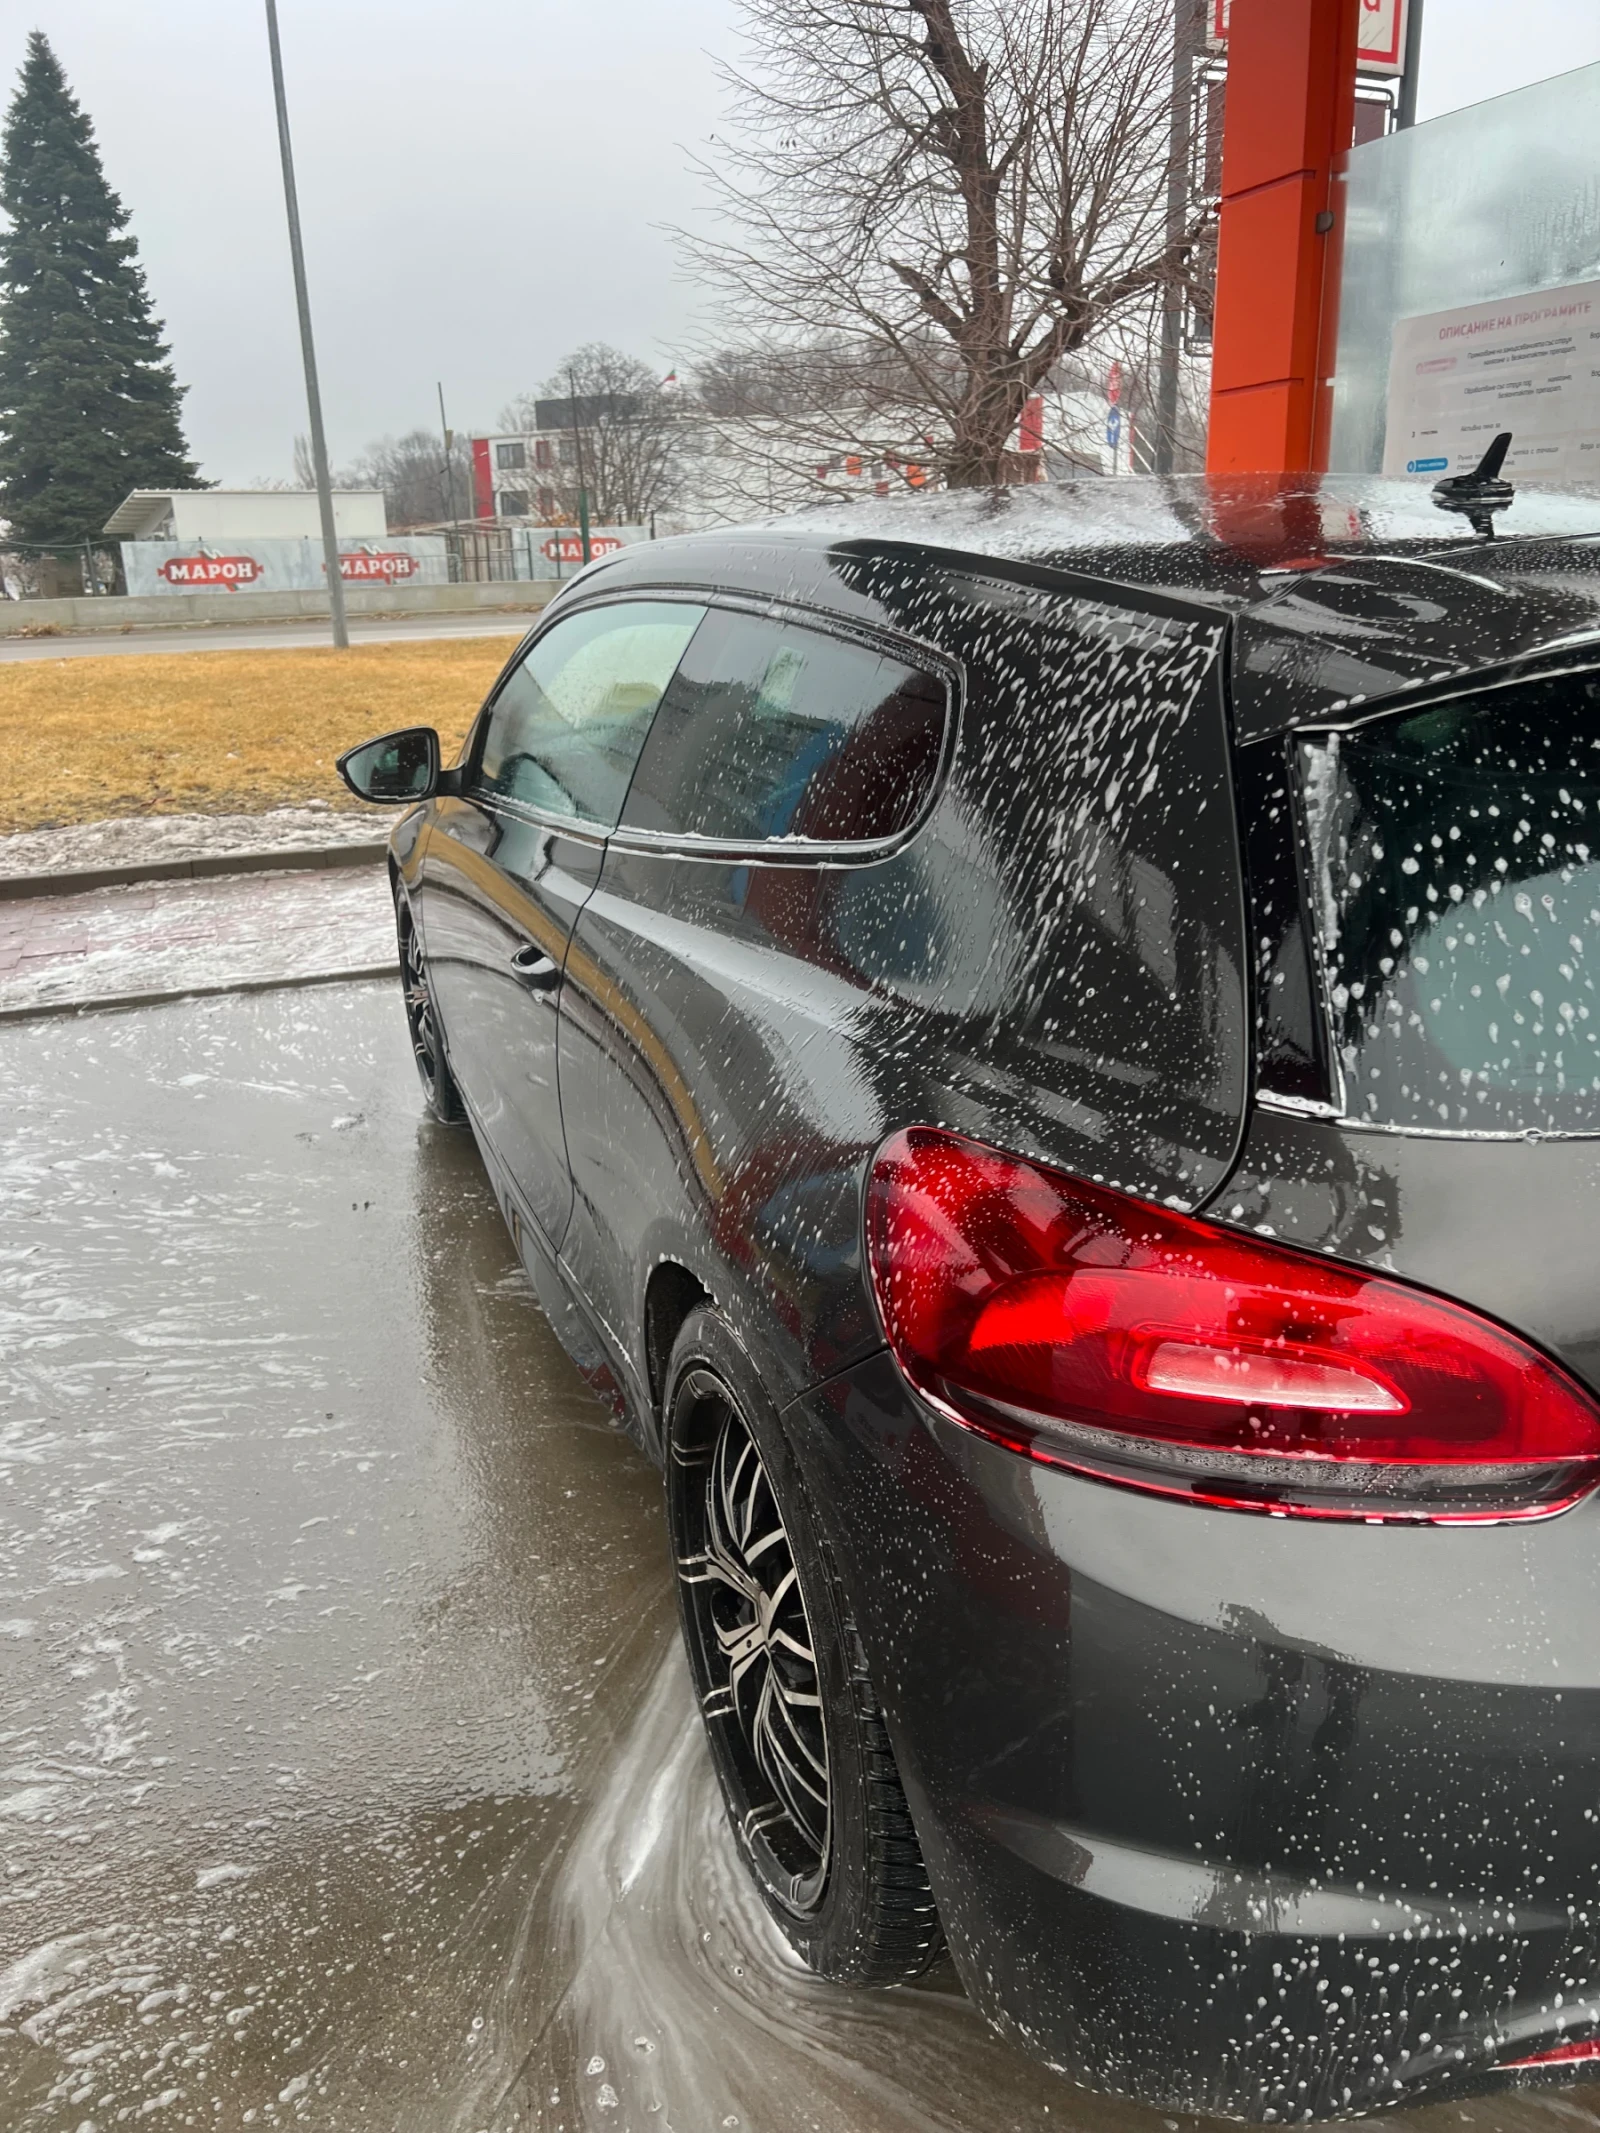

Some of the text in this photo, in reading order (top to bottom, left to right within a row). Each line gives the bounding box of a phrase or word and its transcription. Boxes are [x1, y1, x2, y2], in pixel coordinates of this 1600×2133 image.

[1439, 300, 1592, 340] ОПИСАНИЕ НА ПРОГРАМИТЕ
[549, 542, 617, 557] МАОН
[169, 562, 253, 580] МАРОН
